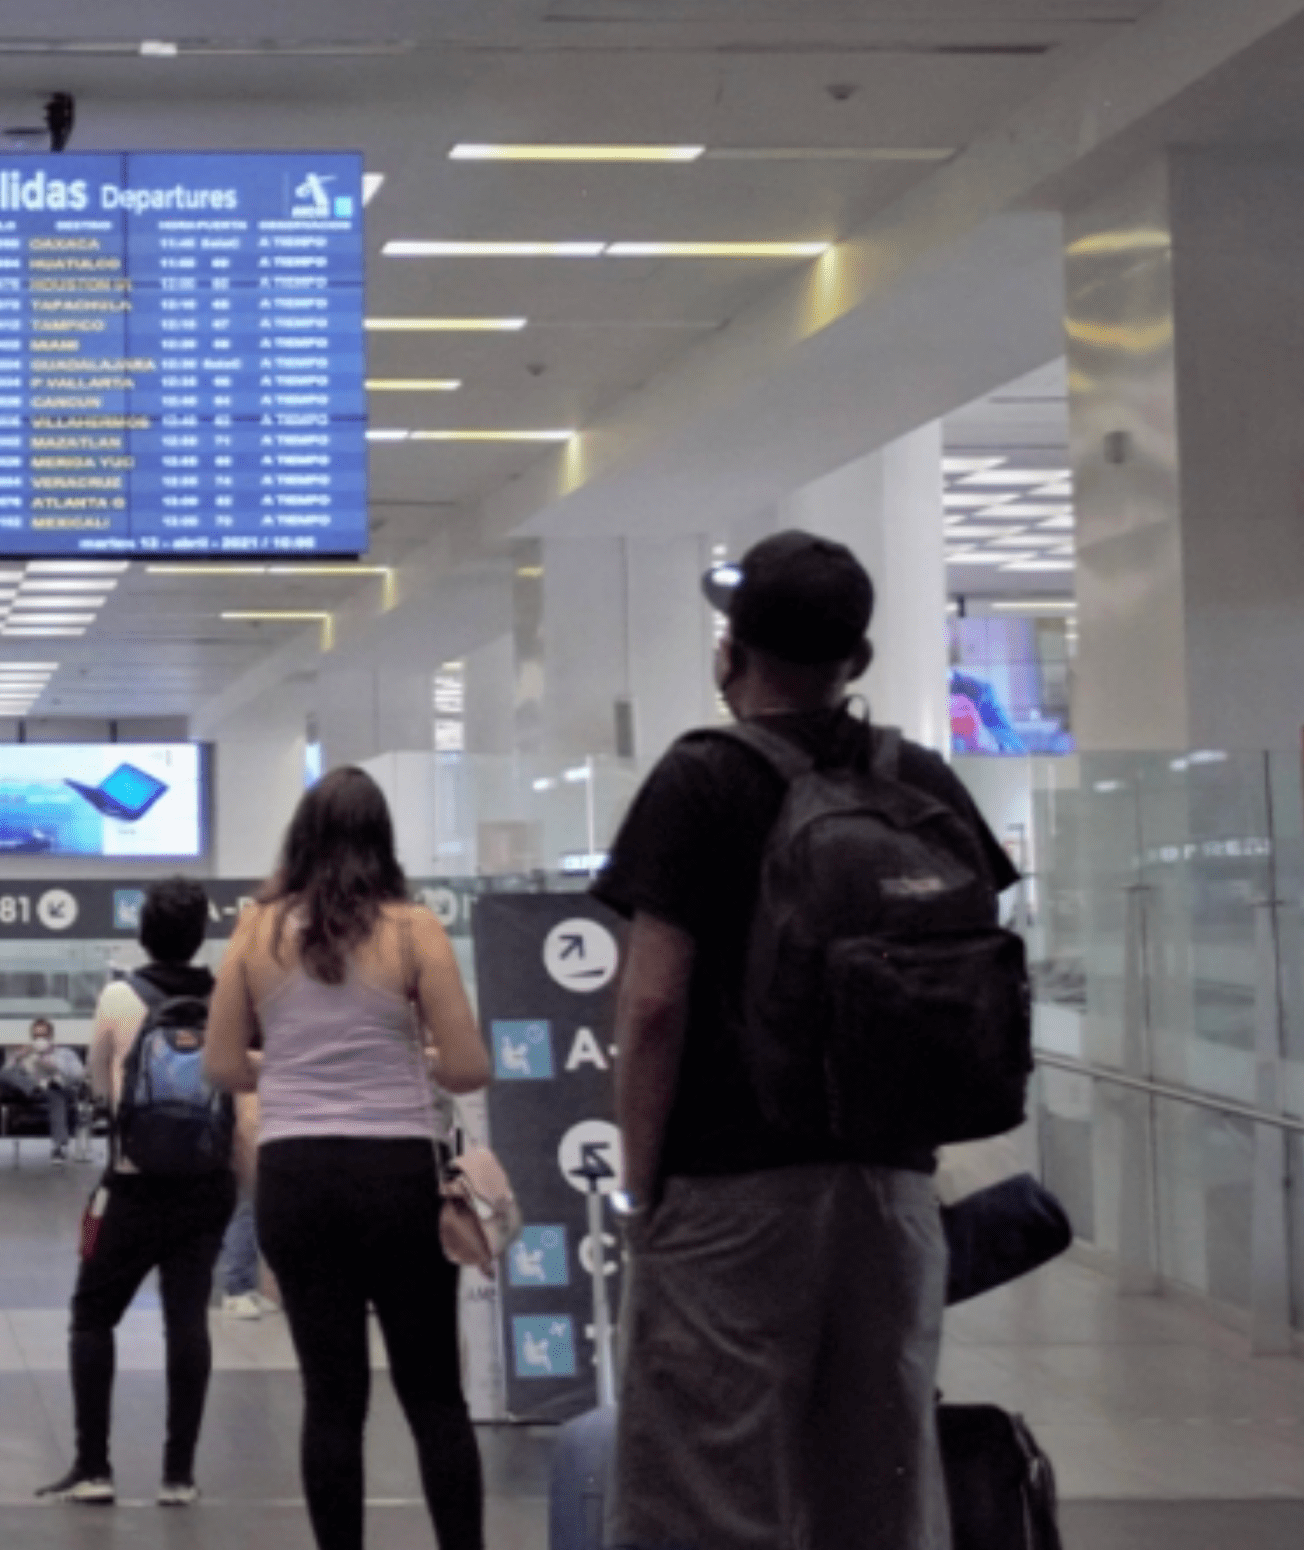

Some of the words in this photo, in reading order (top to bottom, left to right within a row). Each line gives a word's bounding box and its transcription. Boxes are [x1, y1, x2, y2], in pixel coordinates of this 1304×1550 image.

[100, 183, 237, 215] Departures
[28, 238, 101, 251] OAXACA
[31, 318, 107, 332] TAMPICO
[29, 396, 103, 409] CANCUN
[32, 497, 107, 509] ATLANTA
